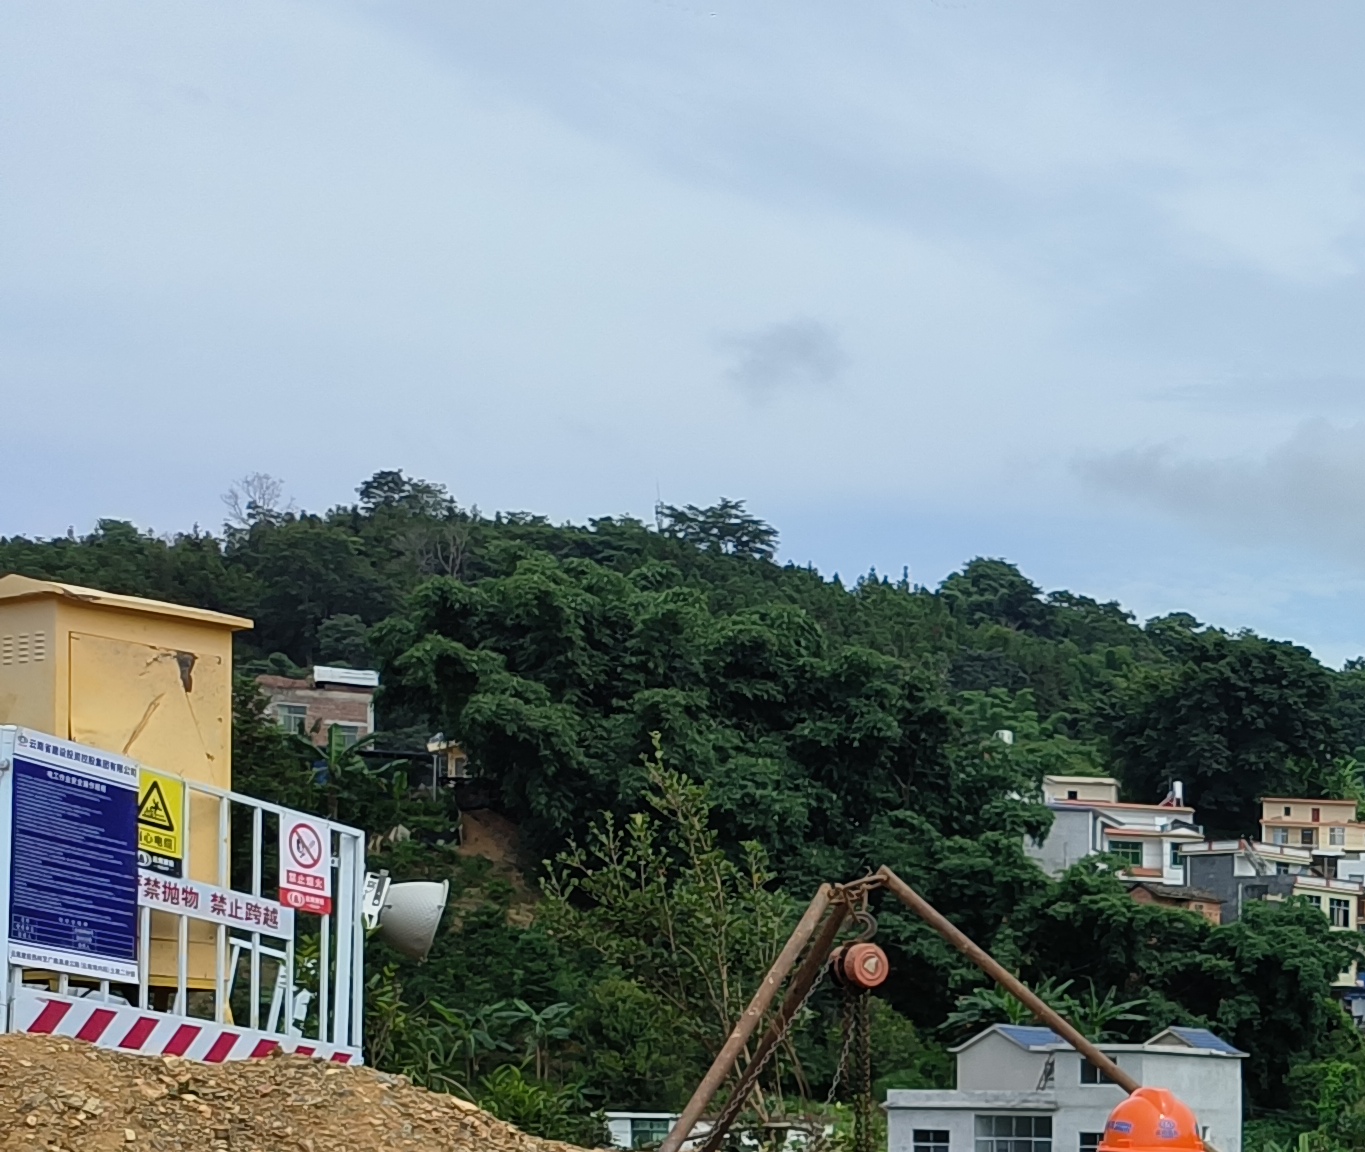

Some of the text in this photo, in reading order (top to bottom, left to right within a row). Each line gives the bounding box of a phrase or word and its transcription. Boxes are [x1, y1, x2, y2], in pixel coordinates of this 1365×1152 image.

[139, 830, 174, 850] 心电缆
[210, 891, 279, 930] 禁止跨越
